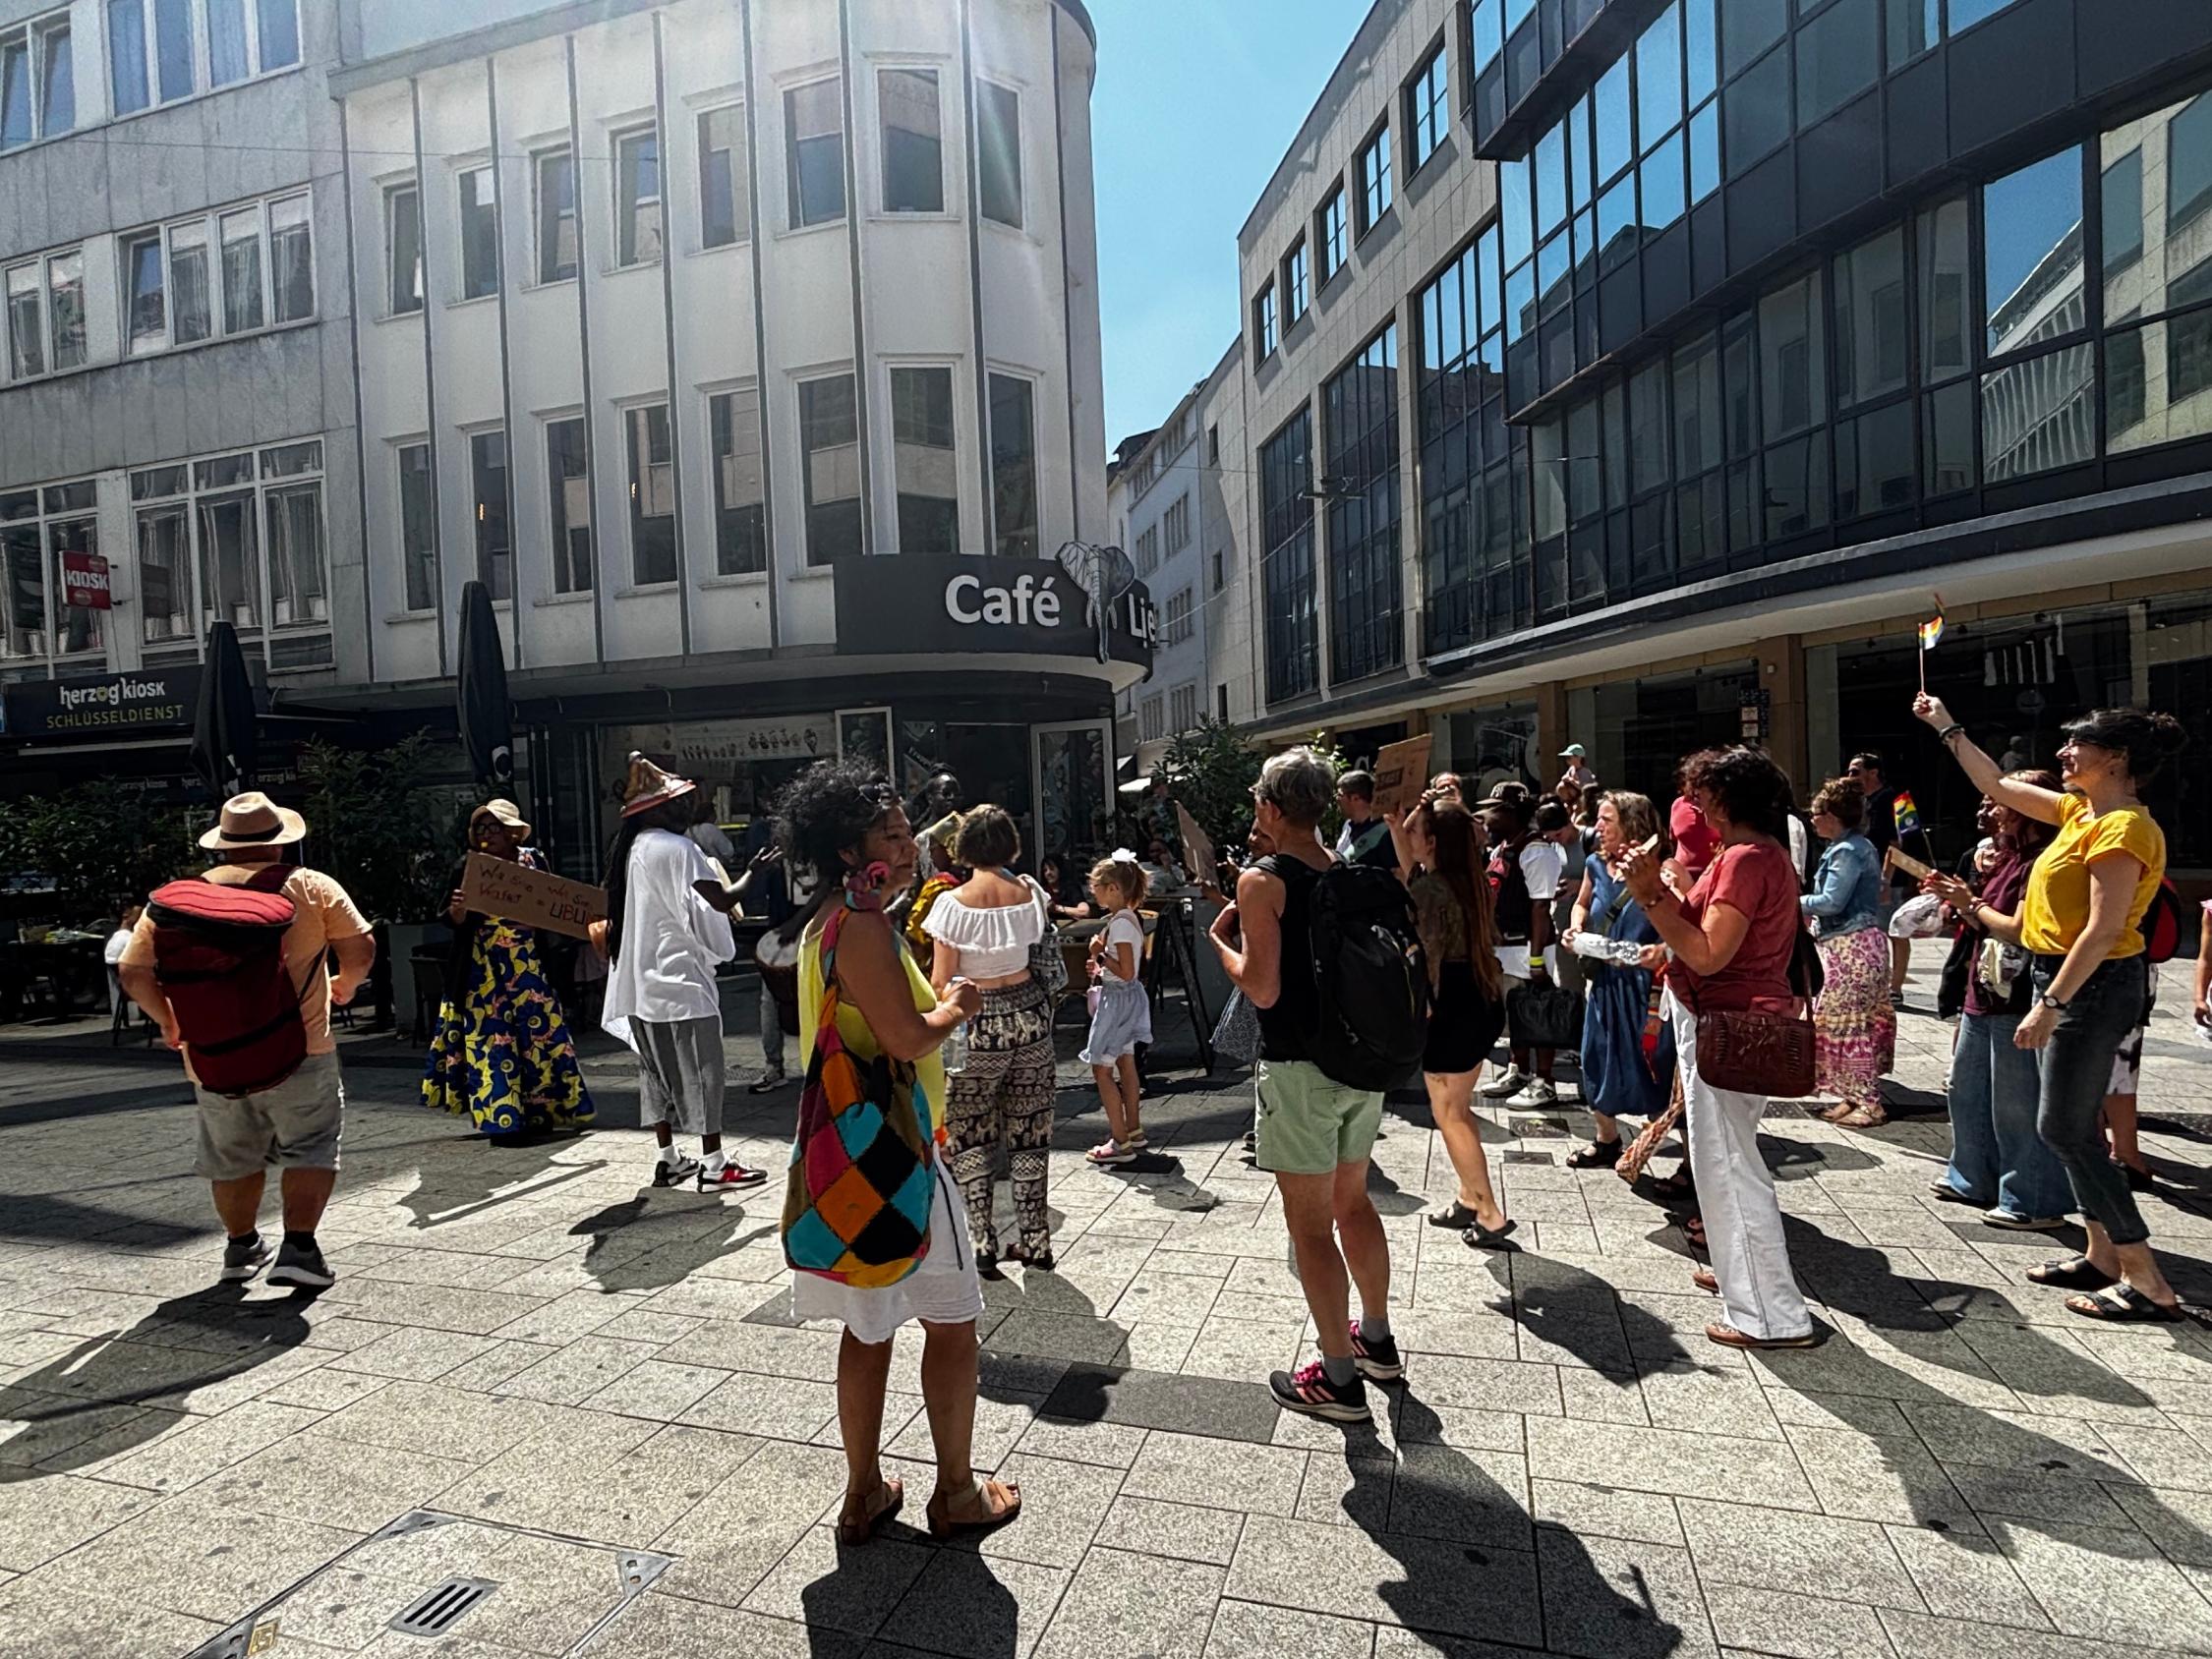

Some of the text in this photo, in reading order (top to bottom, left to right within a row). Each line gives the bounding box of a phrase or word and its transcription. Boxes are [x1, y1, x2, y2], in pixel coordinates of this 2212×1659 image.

[66, 569, 109, 591] KIOSK
[945, 574, 1061, 627] Café
[46, 705, 184, 729] SCHLÜSSELDIENST
